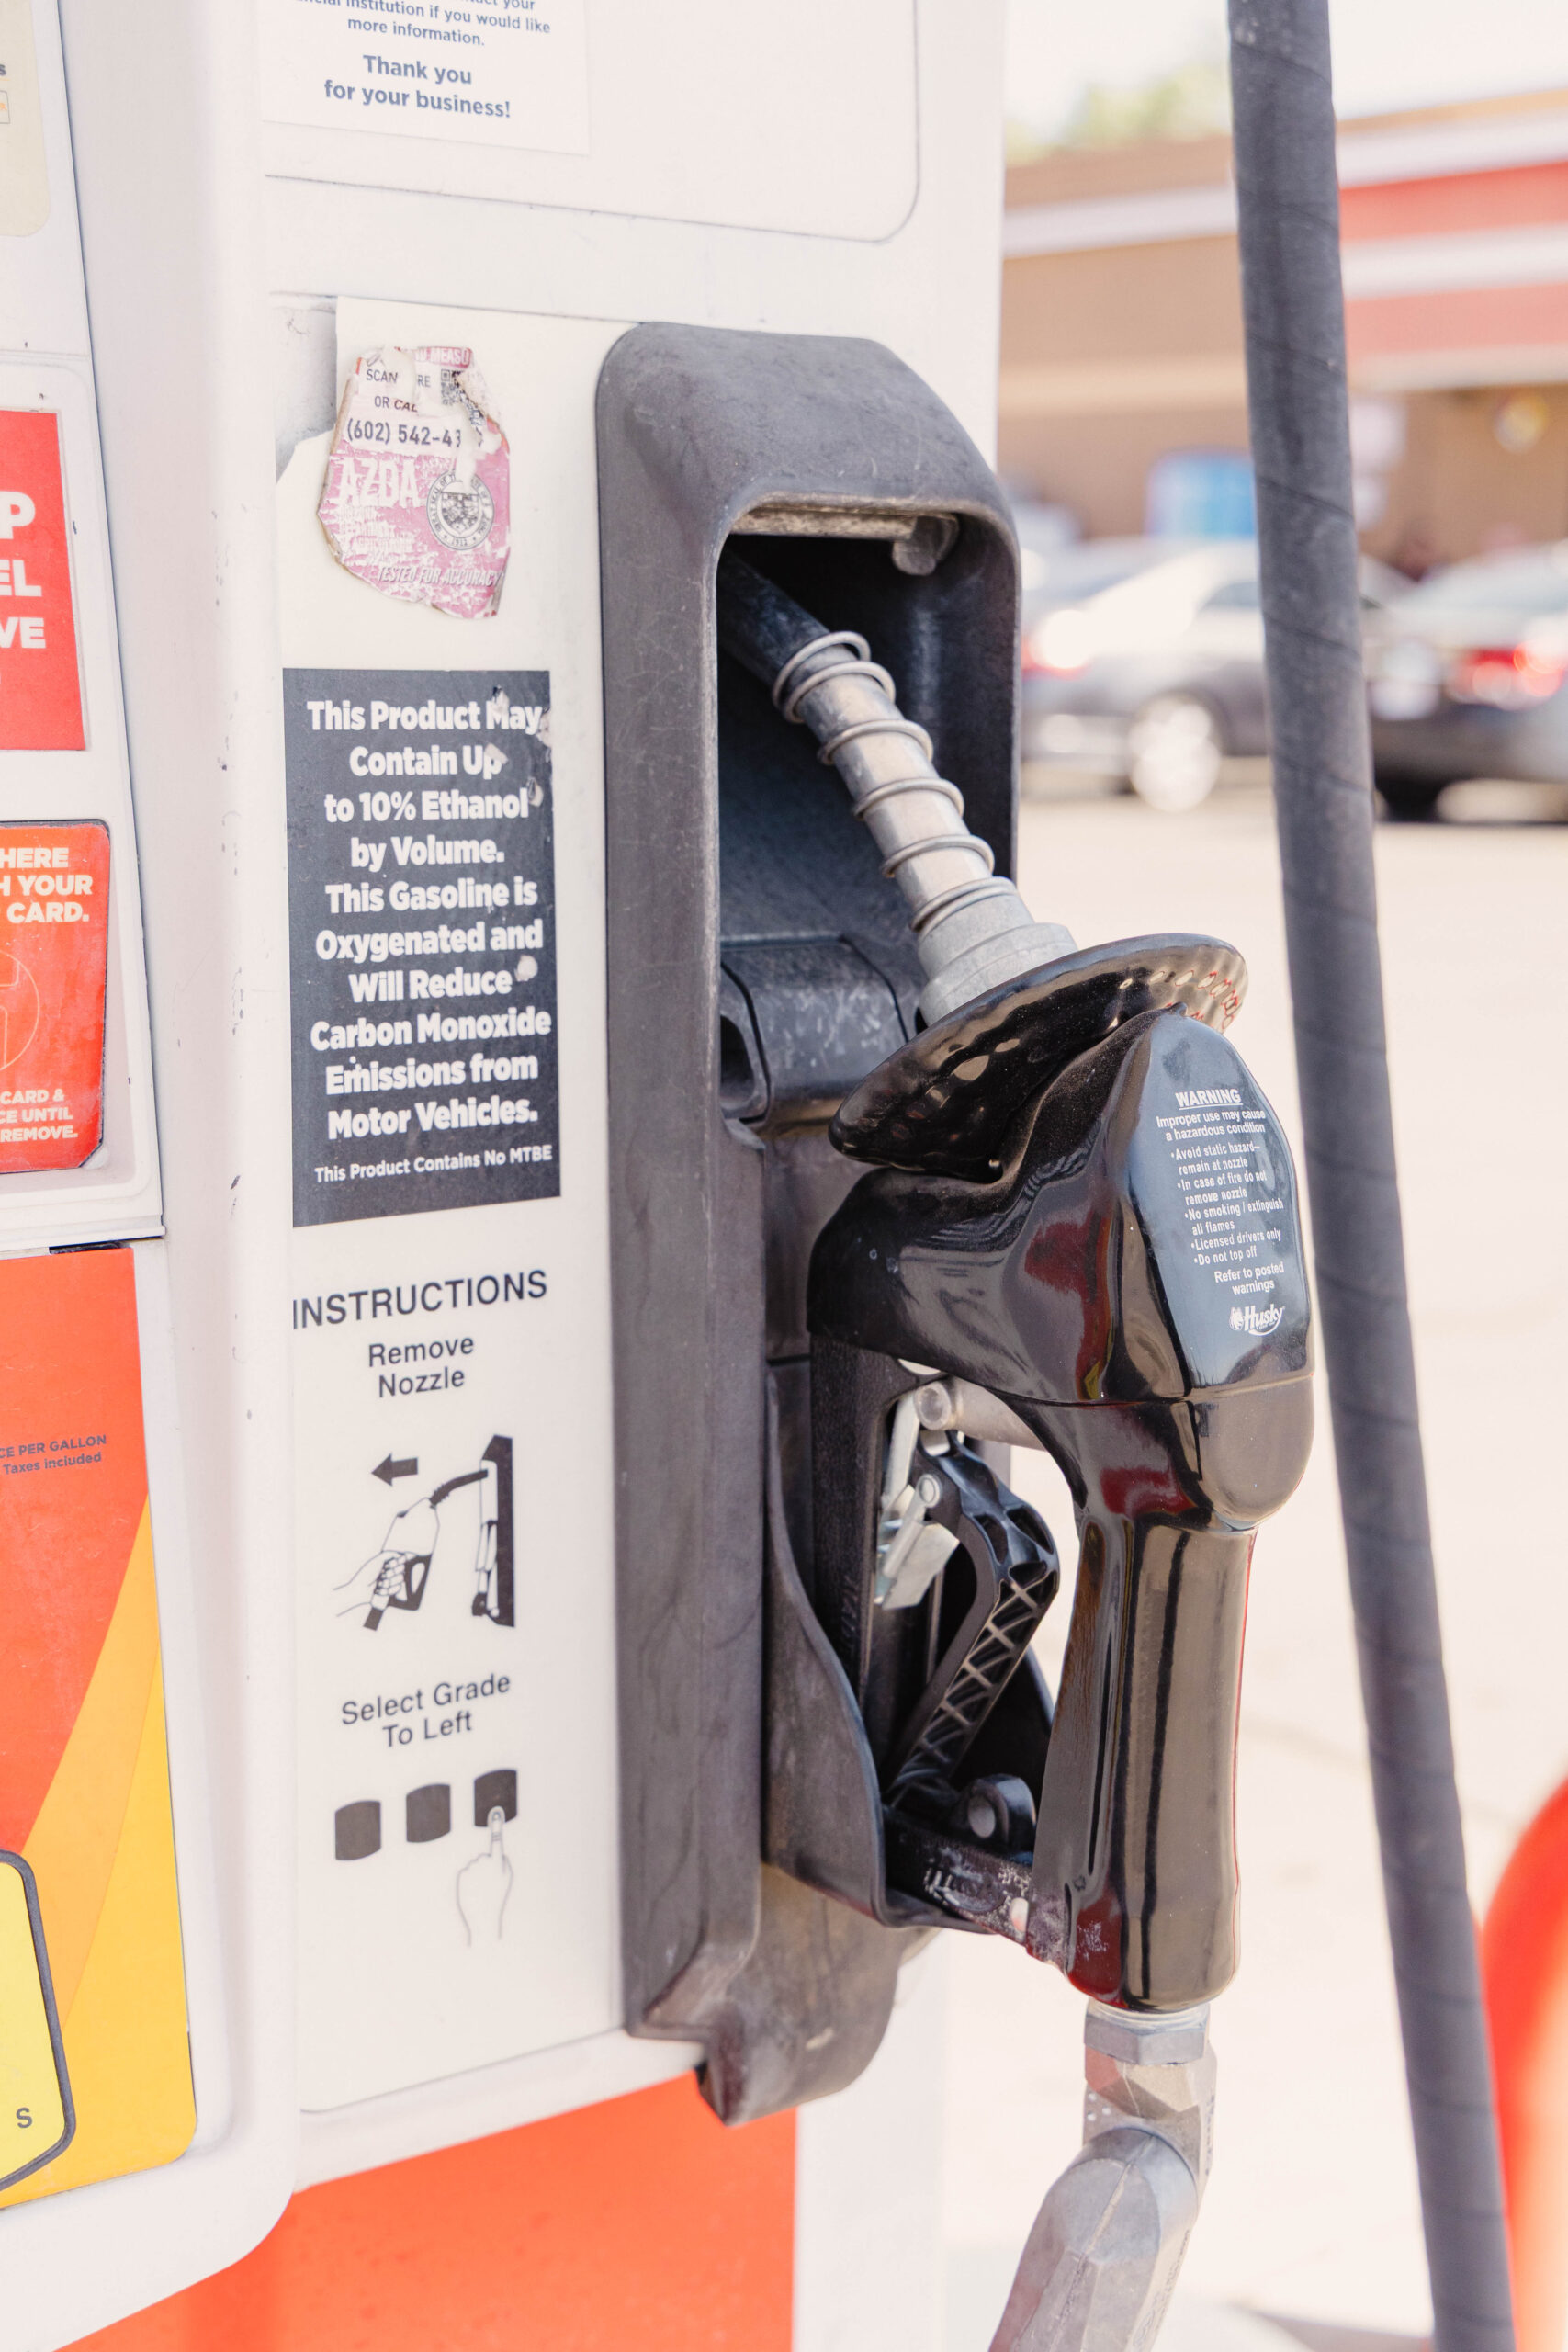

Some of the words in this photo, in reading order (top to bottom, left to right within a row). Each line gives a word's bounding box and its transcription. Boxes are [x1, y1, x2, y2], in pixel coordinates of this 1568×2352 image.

[429, 5, 439, 19] if
[445, 10, 471, 24] you
[476, 14, 520, 29] would
[525, 18, 550, 34] like
[348, 17, 388, 33] more
[393, 21, 485, 46] information.
[363, 54, 427, 79] Thank
[434, 64, 472, 85] you
[324, 80, 355, 101] for
[362, 87, 410, 107] your
[416, 90, 511, 119] business!
[366, 368, 398, 384] SCAN
[374, 396, 390, 409] OR
[347, 418, 390, 445] (602)
[420, 569, 441, 584] FOR
[307, 700, 366, 730] This
[370, 700, 480, 730] Product
[486, 701, 542, 735] May
[349, 744, 457, 776] Contain
[462, 745, 503, 780] Up
[324, 794, 355, 822] to
[359, 791, 416, 821] 10%
[422, 787, 529, 820] Ethanol
[351, 837, 387, 872] by
[390, 834, 504, 865] Volume.
[17, 874, 93, 896] YOUR
[325, 882, 384, 913] This
[389, 877, 509, 911] Gasoline
[513, 876, 538, 906] is
[6, 901, 89, 923] CARD.
[316, 921, 485, 963] Oxygenated
[490, 918, 544, 950] and
[348, 970, 404, 1003] Will
[410, 967, 513, 999] Reduce
[310, 1017, 412, 1051] Carbon
[417, 1006, 551, 1043] Monoxide
[326, 1058, 466, 1095] Emissions
[470, 1053, 538, 1083] from
[0, 1091, 49, 1104] CARD
[52, 1088, 64, 1102] &
[1175, 1088, 1242, 1108] WARNING
[22, 1106, 73, 1122] UNTIL
[328, 1107, 412, 1140] Motor
[415, 1095, 538, 1132] Vehicles.
[1156, 1113, 1201, 1129] Improper
[1203, 1113, 1220, 1123] use
[1222, 1110, 1240, 1123] may
[1241, 1109, 1266, 1119] cause
[0, 1125, 79, 1142] REMOVE.
[1165, 1131, 1173, 1141] a
[1174, 1125, 1225, 1141] hazardous
[1226, 1123, 1266, 1135] condition
[1176, 1146, 1201, 1160] Avoid
[1203, 1144, 1228, 1156] static
[314, 1167, 346, 1183] This
[350, 1159, 410, 1179] Product
[413, 1152, 480, 1173] Contains
[484, 1150, 506, 1166] No
[509, 1145, 553, 1163] MTBE
[1179, 1161, 1211, 1175] remain
[1213, 1159, 1222, 1170] at
[1223, 1157, 1248, 1170] nozzle
[1181, 1177, 1191, 1191] In
[1193, 1178, 1215, 1189] case
[1217, 1174, 1226, 1185] of
[1227, 1172, 1242, 1184] fire
[1244, 1171, 1254, 1182] do
[1256, 1170, 1267, 1182] not
[1185, 1192, 1219, 1205] remove
[1221, 1187, 1247, 1200] nozzle
[1203, 1202, 1241, 1217] smoking
[1247, 1197, 1284, 1214] extinguish
[1192, 1223, 1203, 1236] all
[1205, 1220, 1235, 1233] flames
[1194, 1234, 1235, 1250] Licensed
[1237, 1230, 1265, 1243] drivers
[1267, 1227, 1281, 1241] only
[1198, 1253, 1211, 1266] Do
[1213, 1250, 1227, 1263] not
[1229, 1250, 1244, 1261] top
[1246, 1245, 1258, 1258] off
[1214, 1269, 1241, 1283] Refer
[1243, 1267, 1253, 1278] to
[1255, 1261, 1284, 1280] posted
[1233, 1279, 1275, 1295] warnings
[293, 1270, 547, 1330] INSTRUCTIONS
[1244, 1303, 1283, 1335] Husky
[368, 1337, 474, 1367] Remove
[379, 1367, 465, 1398] Nozzle
[18, 1442, 45, 1456] PER
[49, 1434, 107, 1452] GALLON
[3, 1461, 40, 1475] Taxes
[44, 1452, 102, 1468] included
[342, 1689, 423, 1725] Select
[434, 1673, 511, 1706] Grade
[382, 1724, 413, 1747] To
[424, 1710, 473, 1740] Left
[16, 2107, 33, 2129] S
